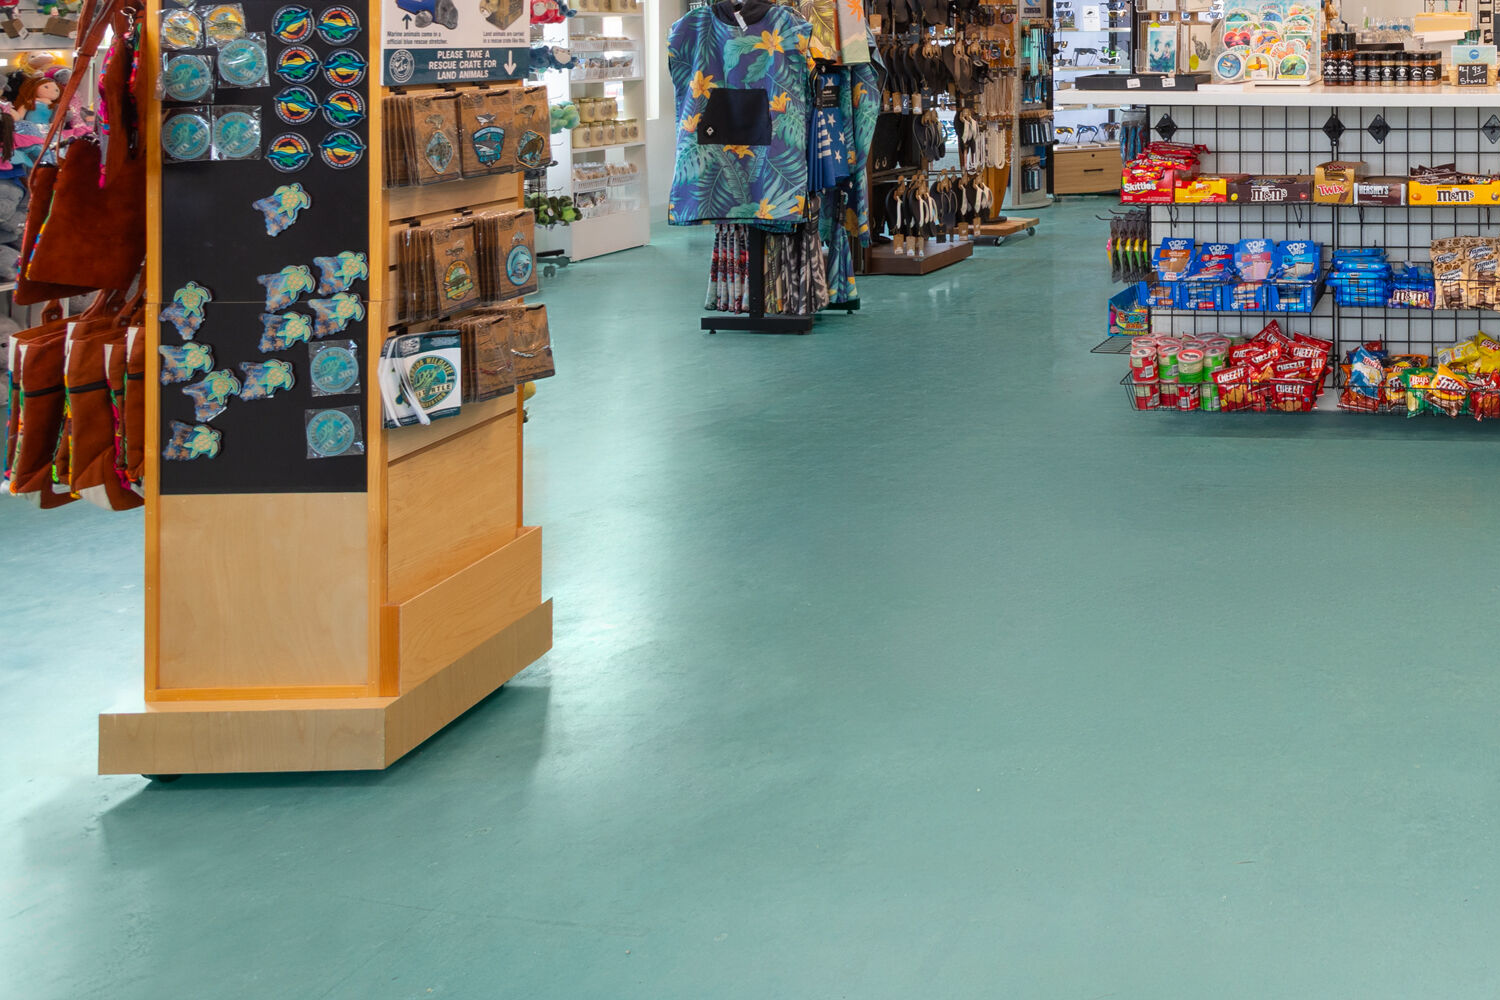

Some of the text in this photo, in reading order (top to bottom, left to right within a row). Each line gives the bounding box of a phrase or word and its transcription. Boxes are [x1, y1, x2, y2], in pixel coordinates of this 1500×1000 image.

[437, 50, 490, 59] PLEASE TAKE A
[428, 60, 496, 70] RESCUE CRATE FOR
[437, 70, 488, 80] LAND ANIMALS
[1124, 182, 1157, 193] Skittles
[1317, 183, 1345, 196] Twix
[1437, 376, 1466, 395] Fritos
